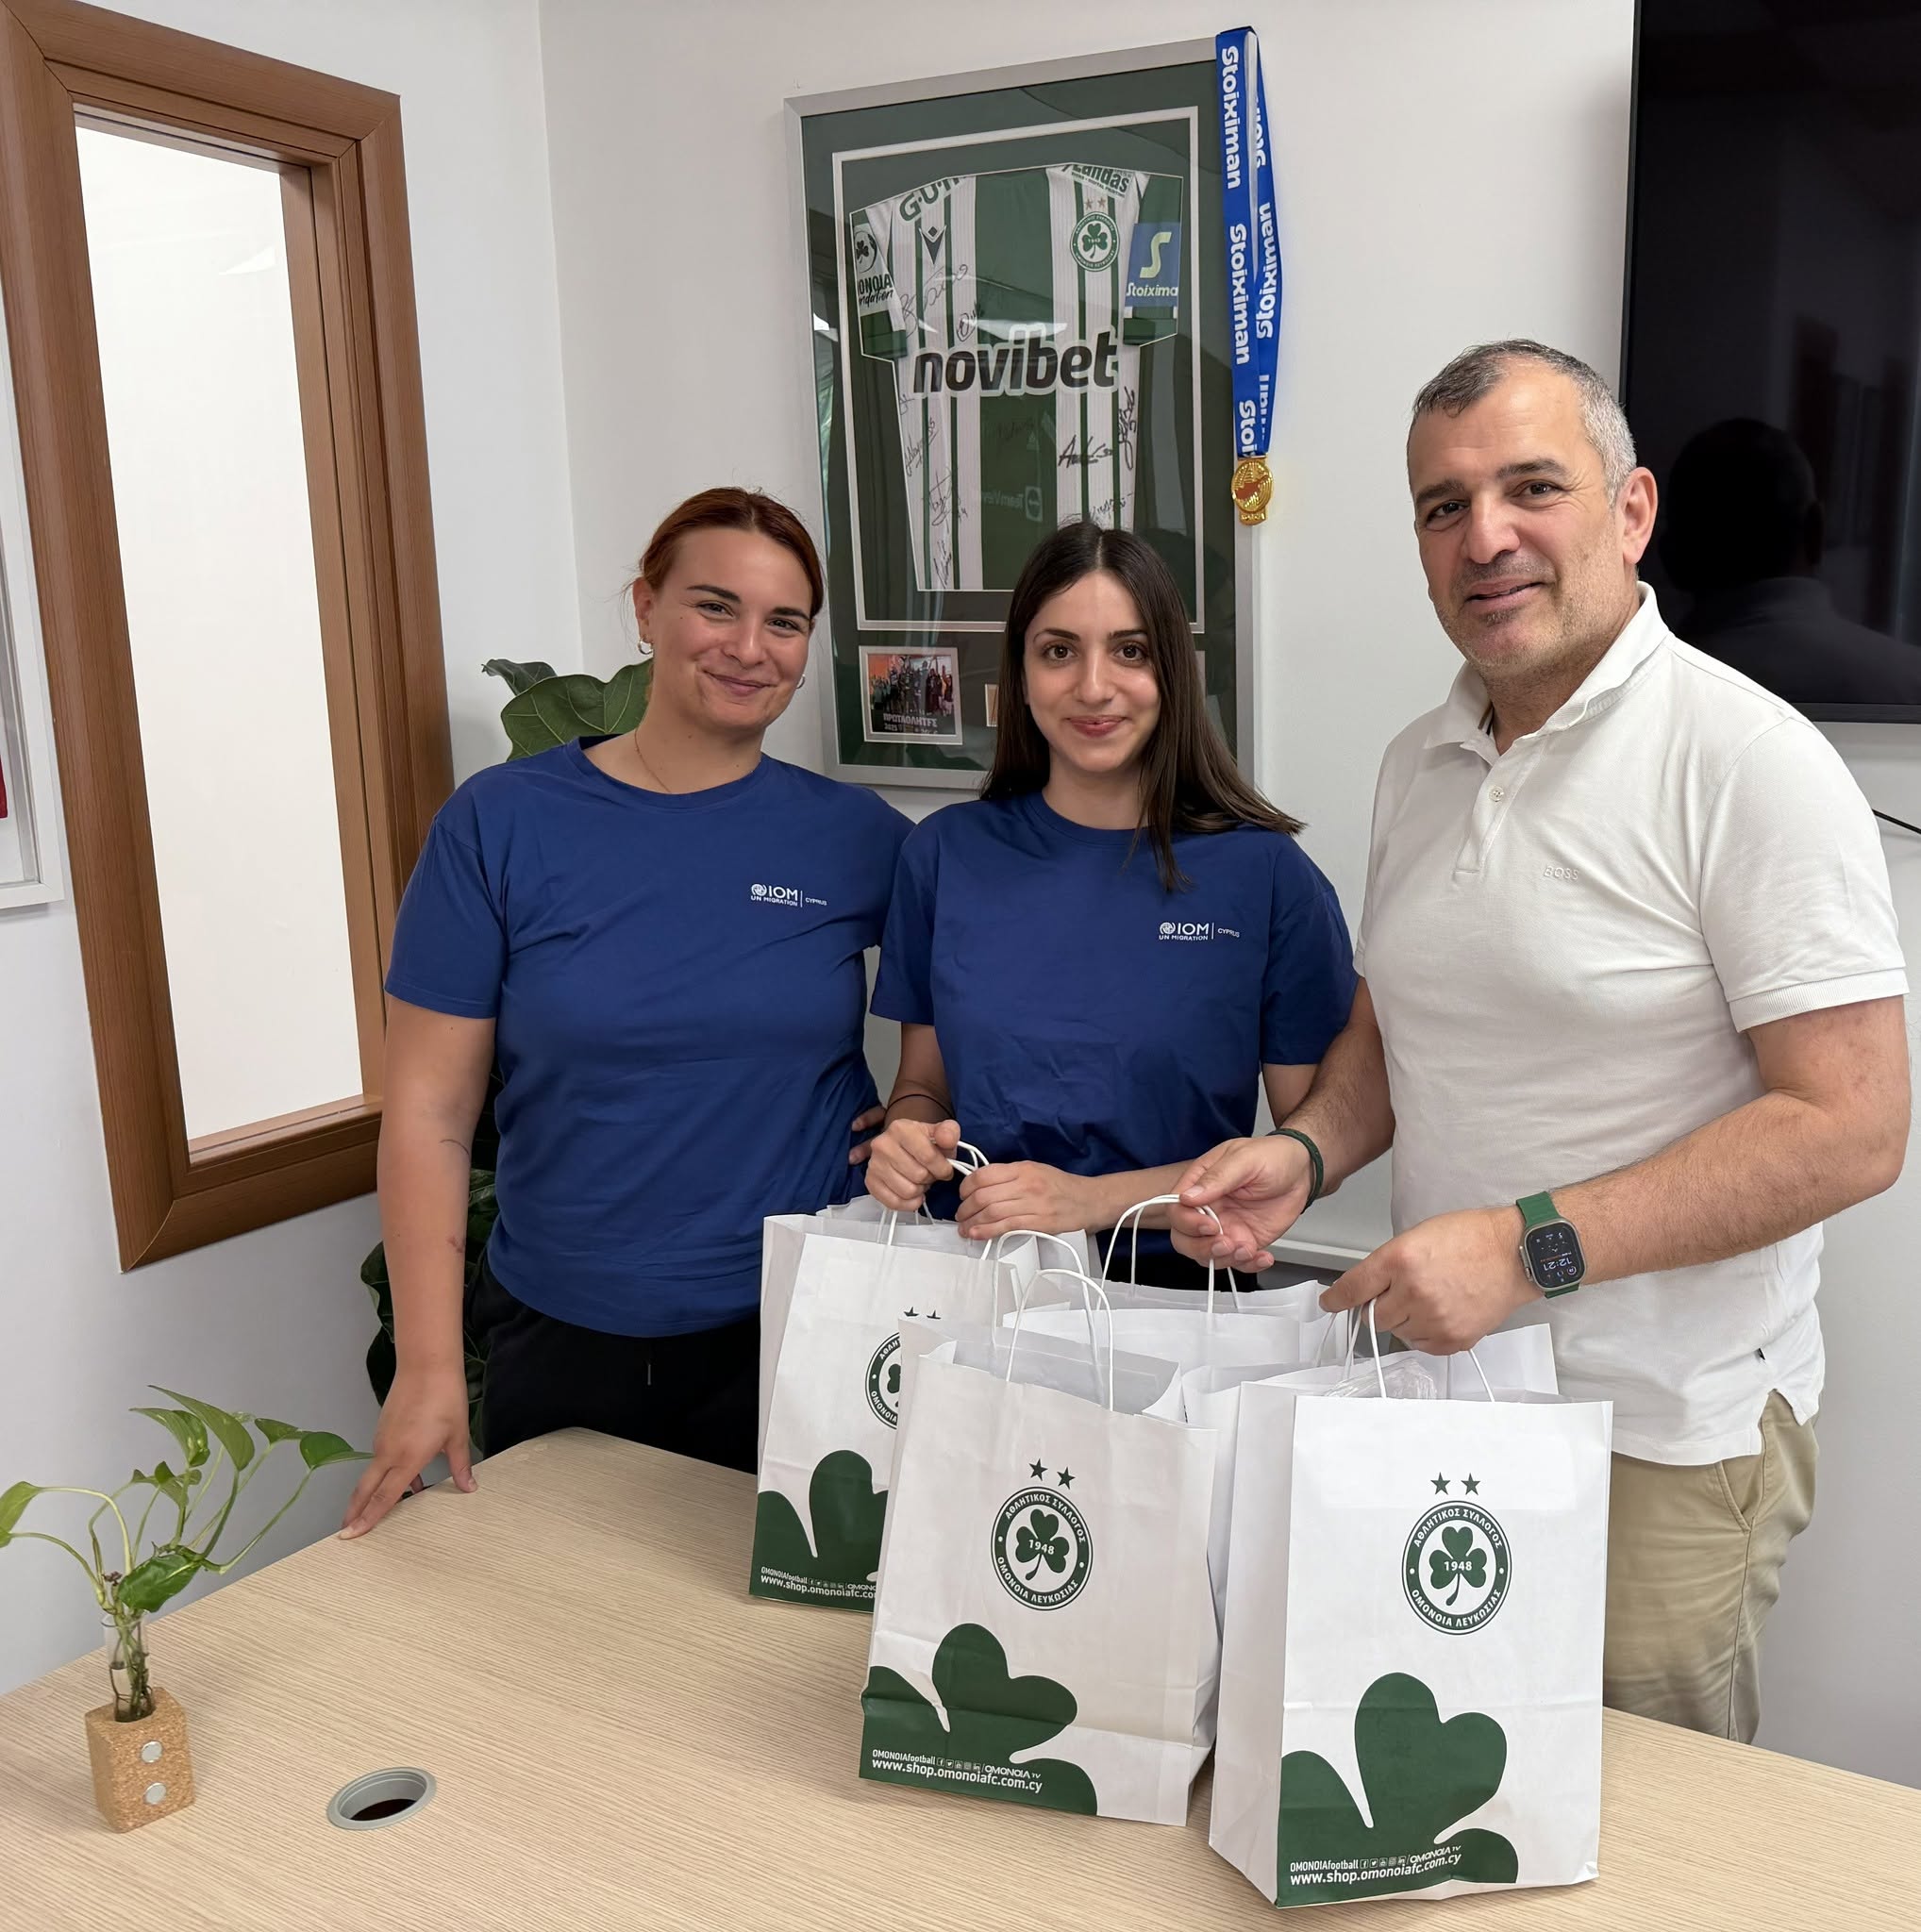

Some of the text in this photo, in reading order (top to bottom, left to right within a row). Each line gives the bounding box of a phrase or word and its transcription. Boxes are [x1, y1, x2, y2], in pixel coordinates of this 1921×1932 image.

[1222, 45, 1242, 189] Stoiximan
[1256, 202, 1278, 339] Stoiximan
[858, 273, 893, 295] ONOIA
[1229, 223, 1250, 365] Stoiximan
[913, 327, 1117, 393] novibet
[1544, 865, 1579, 880] BOSS
[763, 896, 798, 907] MIGRATION
[768, 885, 798, 901] IOM
[805, 897, 827, 906] CYPRUS
[1178, 922, 1210, 936] IOM
[1217, 927, 1240, 938] CYPRUS
[1543, 1257, 1573, 1272] 12:21
[1005, 1493, 1086, 1543] ΑΘΛΗΤΙΚΟΣ ΣΥΛΛΟΓΟΣ
[1413, 1507, 1503, 1549] ΑΘΛΗΤΙΚΟΣ ΣΥΛΛΟΓΟΣ
[1028, 1539, 1055, 1556] 1948
[1444, 1560, 1473, 1571] 1948
[760, 1574, 877, 1599] www.shop.omonoiafc.co
[997, 1557, 1078, 1604] ΟΜΟΝΟΙΑ ΛΕΥΚΩΣΙΑΣ
[1412, 1589, 1501, 1627] ΟΜΟΝΟΙΑ ΛΕΥΚΩΣΙΑΣ
[872, 1749, 936, 1765] OMONOIAfootball
[872, 1759, 1043, 1793] www.shop.omonoiafc.com.cy
[1290, 1859, 1359, 1873] OMONOIAfootball
[1290, 1853, 1462, 1886] www.shop.omonoiafc.com.cy
